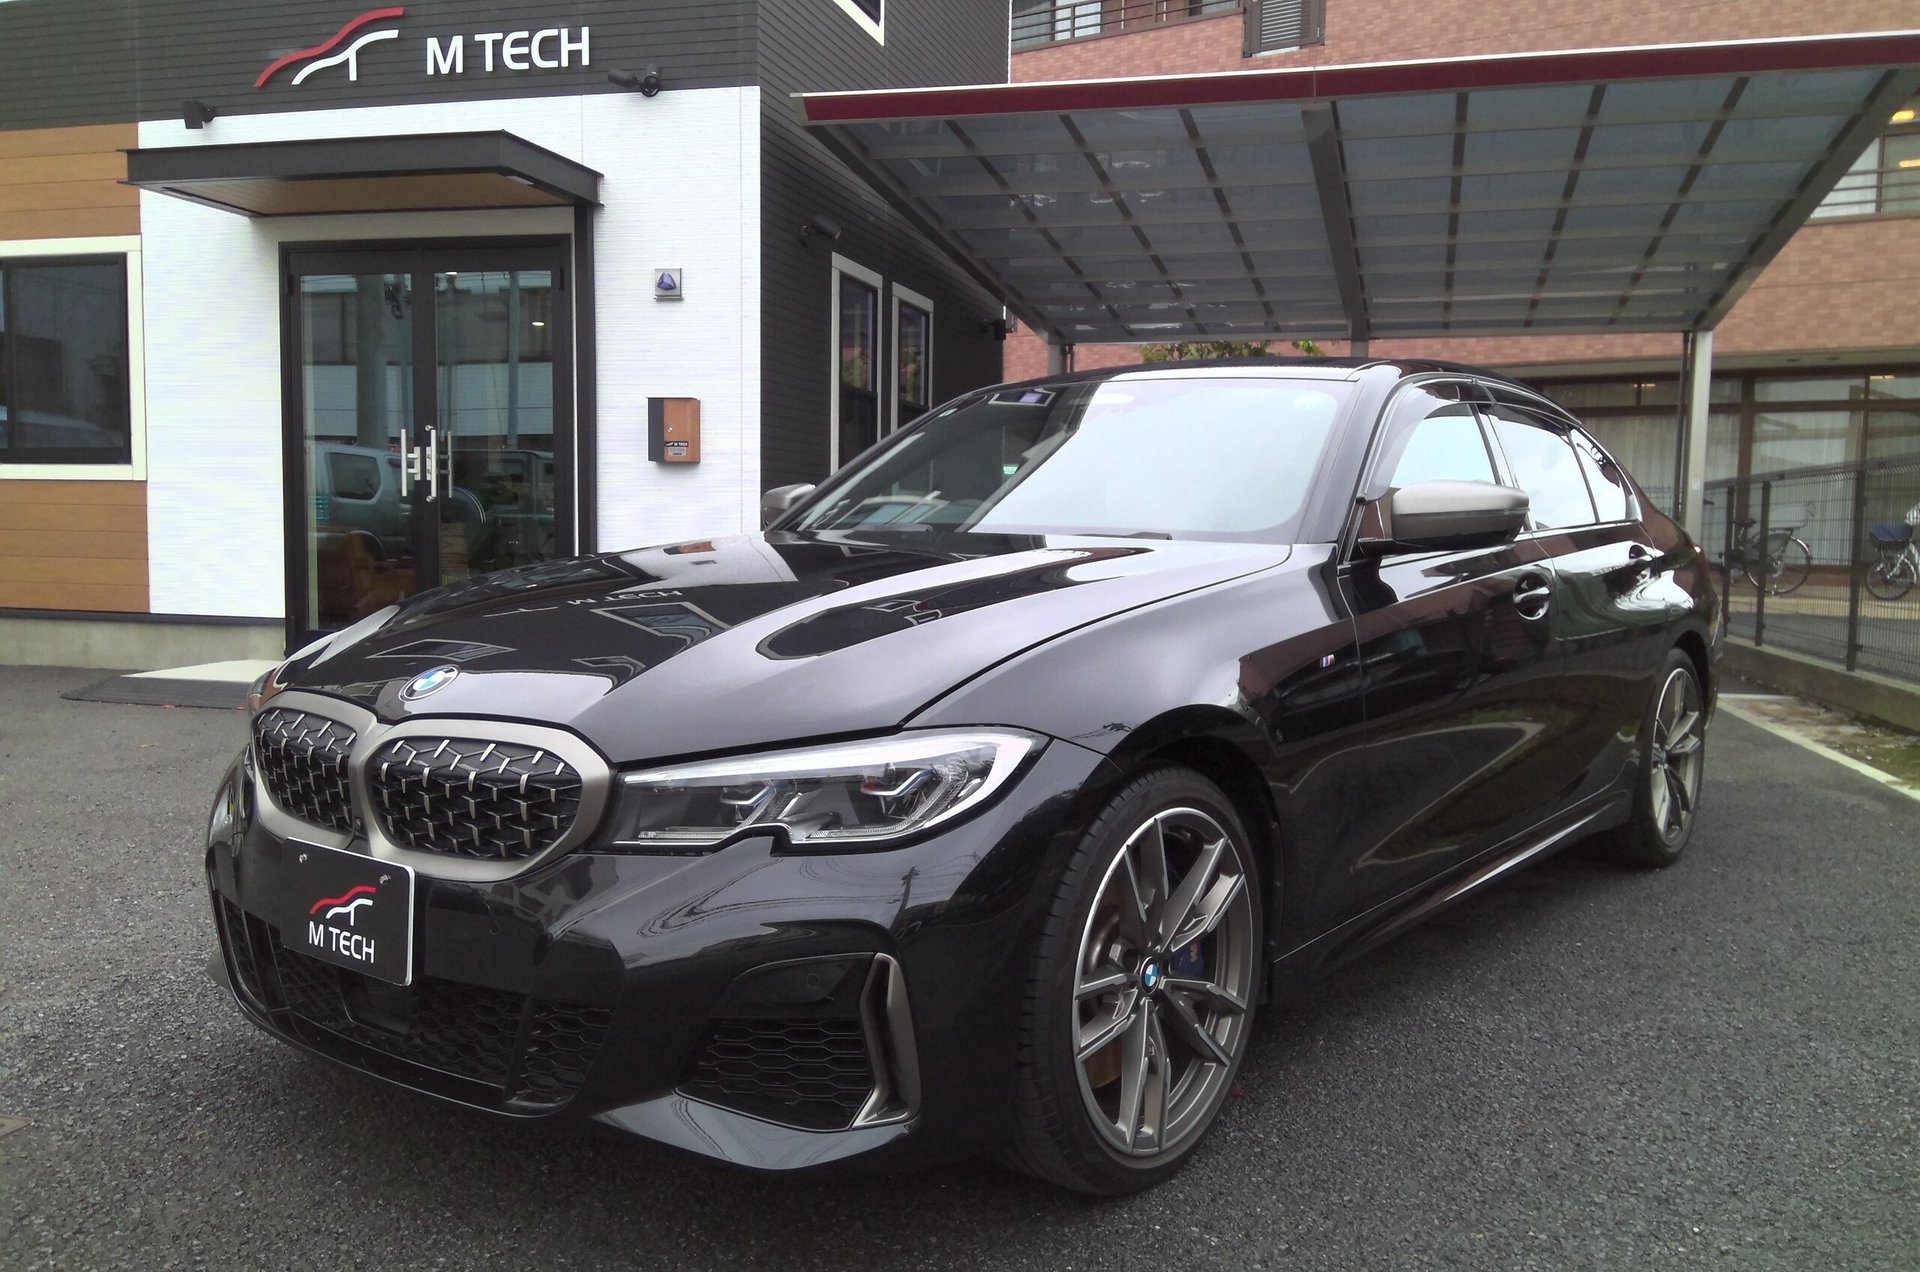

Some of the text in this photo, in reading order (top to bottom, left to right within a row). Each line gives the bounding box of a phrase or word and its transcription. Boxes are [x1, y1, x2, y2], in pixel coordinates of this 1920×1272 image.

[427, 26, 590, 75] M TECH
[309, 920, 375, 964] M TECH
